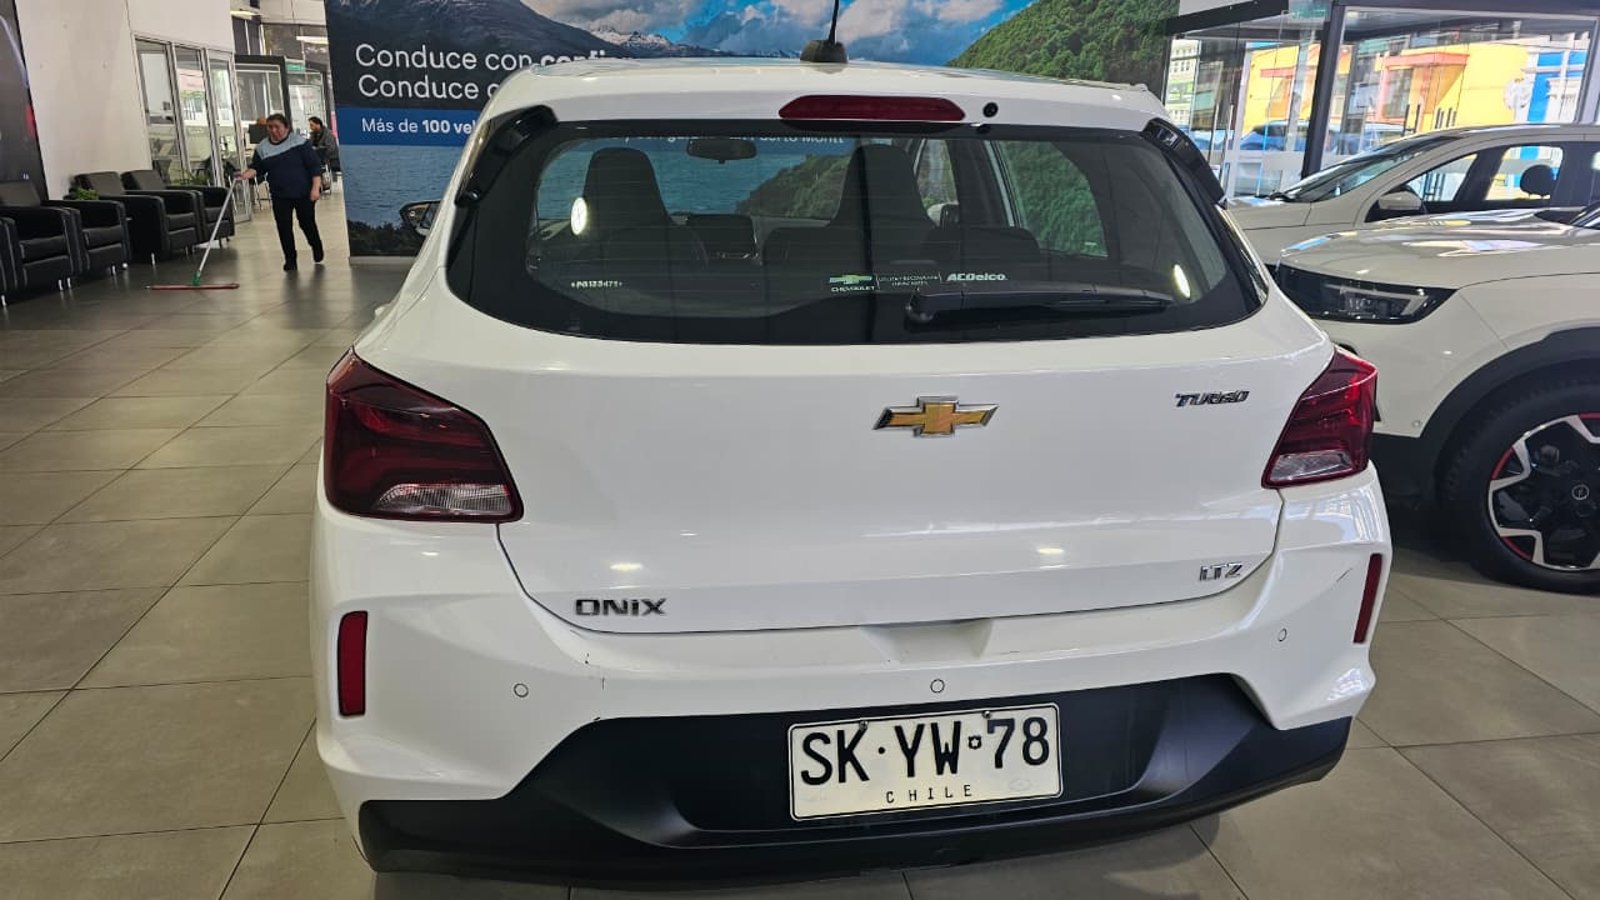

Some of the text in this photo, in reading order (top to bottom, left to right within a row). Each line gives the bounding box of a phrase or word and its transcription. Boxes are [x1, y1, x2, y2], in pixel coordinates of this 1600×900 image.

[355, 43, 478, 69] Conduce
[485, 53, 532, 71] con
[358, 74, 479, 99] Conduce
[362, 117, 394, 132] Más
[398, 118, 418, 132] de
[422, 119, 450, 133] 100
[1175, 389, 1250, 408] TURBO
[1199, 561, 1243, 581] LTZ
[886, 784, 972, 804] CHILE
